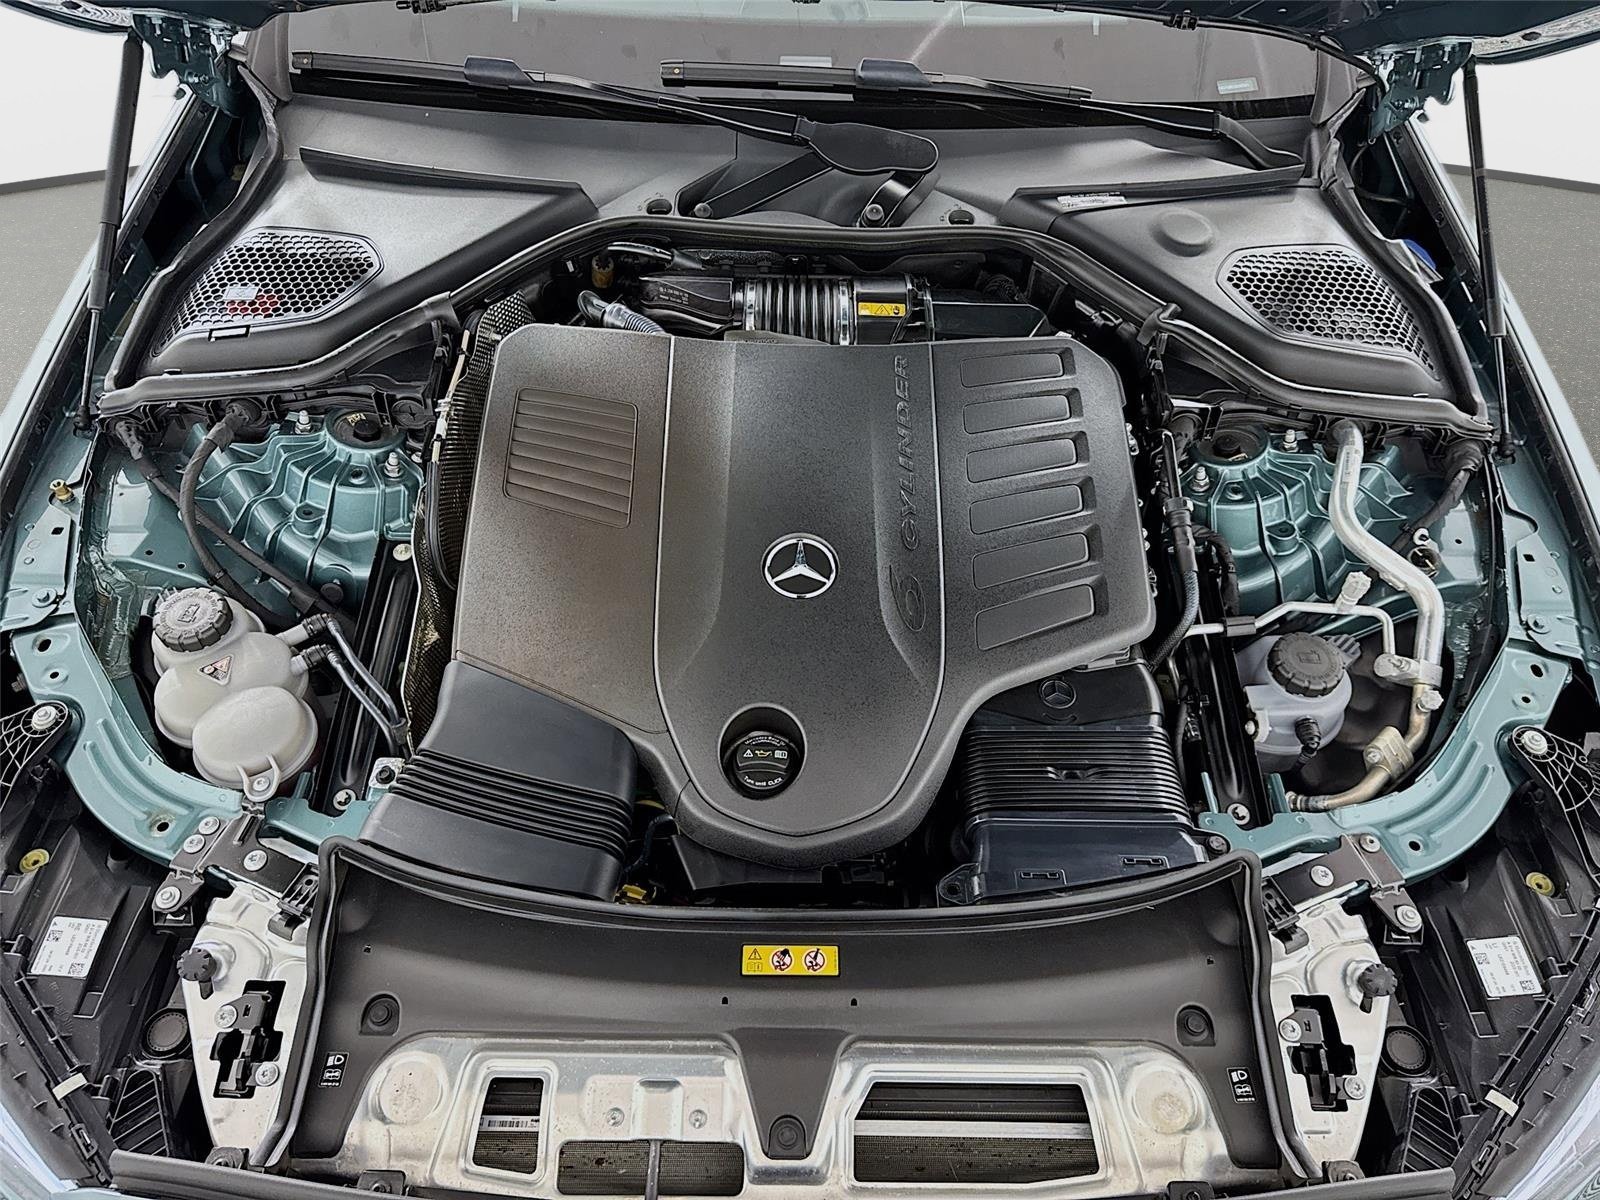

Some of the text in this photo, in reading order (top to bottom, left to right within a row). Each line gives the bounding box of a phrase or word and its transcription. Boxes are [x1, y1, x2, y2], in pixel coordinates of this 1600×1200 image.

[889, 354, 927, 632] 6 CYLINDER
[767, 777, 783, 786] CLICK
